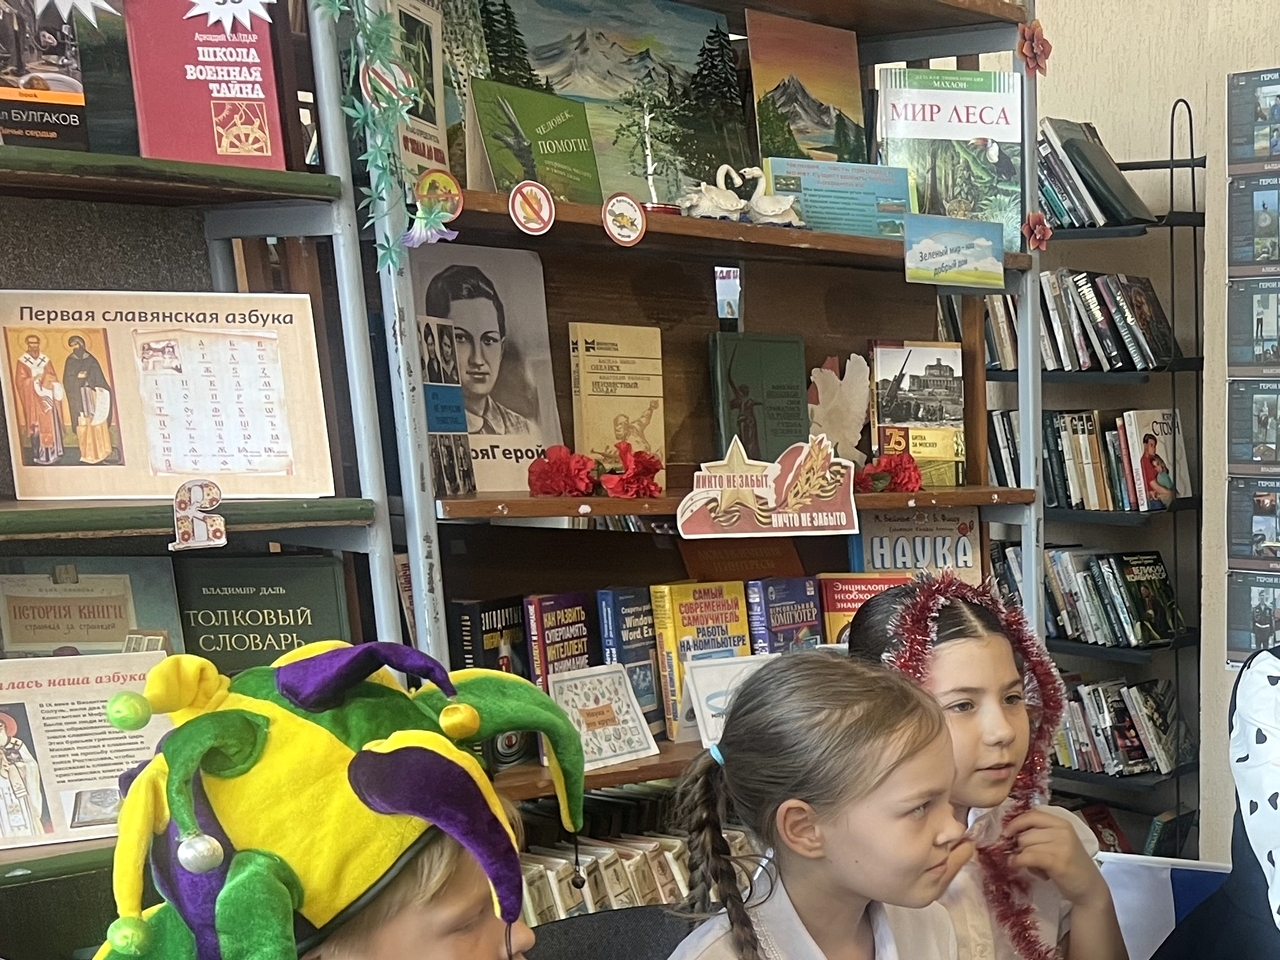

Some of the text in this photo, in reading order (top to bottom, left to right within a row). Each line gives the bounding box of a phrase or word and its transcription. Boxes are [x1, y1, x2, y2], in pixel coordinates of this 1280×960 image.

[196, 46, 261, 63] ШКОЛА
[184, 64, 263, 81] ВОЕННАЯ
[1260, 71, 1278, 81] ГЕРОИ
[208, 80, 266, 98] ТАЙНА
[932, 80, 967, 89] МАХАОН
[11, 109, 80, 126] БУЛГАКОВ
[535, 109, 574, 135] ЧЕЛОВЕК,
[890, 102, 1011, 125] МИР ЛЕСА
[538, 138, 591, 154] ПОМОГИ!
[1259, 177, 1277, 186] ГЕРОИ
[918, 244, 948, 262] Зеленый
[934, 262, 956, 277] добрый
[18, 305, 294, 328] Первая славянская азбука
[885, 429, 906, 451] 75
[695, 473, 771, 490] НИКТО НЕ ЗАБЫТ,
[771, 512, 847, 528] НИЧТО НЕ ЗАБЫТО
[870, 535, 973, 569] НАУКА
[202, 585, 286, 596] ВЛАДИМИР ДАЛЬ
[692, 587, 724, 600] САМЫЙ
[12, 604, 124, 620] ИСТОРИЯ КНИГИ
[678, 598, 740, 615] СОВРЕМЕННЫЙ
[185, 606, 313, 628] ТОЛКОВЫЙ
[543, 605, 586, 628] КАК РАЗВИТЬ
[681, 612, 740, 628] САМОУЧИТЕЛЬ
[544, 623, 588, 644] СУПЕРПАМЯТЬ
[696, 625, 729, 637] РАБОТЫ
[199, 632, 305, 652] СЛОВАРЬ
[546, 637, 589, 662] ИНТЕЛЛЕКТ
[679, 635, 747, 652] НА КОМПЬЮТЕРЕ
[555, 654, 590, 674] ВНИМАНИЕ
[48, 671, 147, 687] наша азбука
